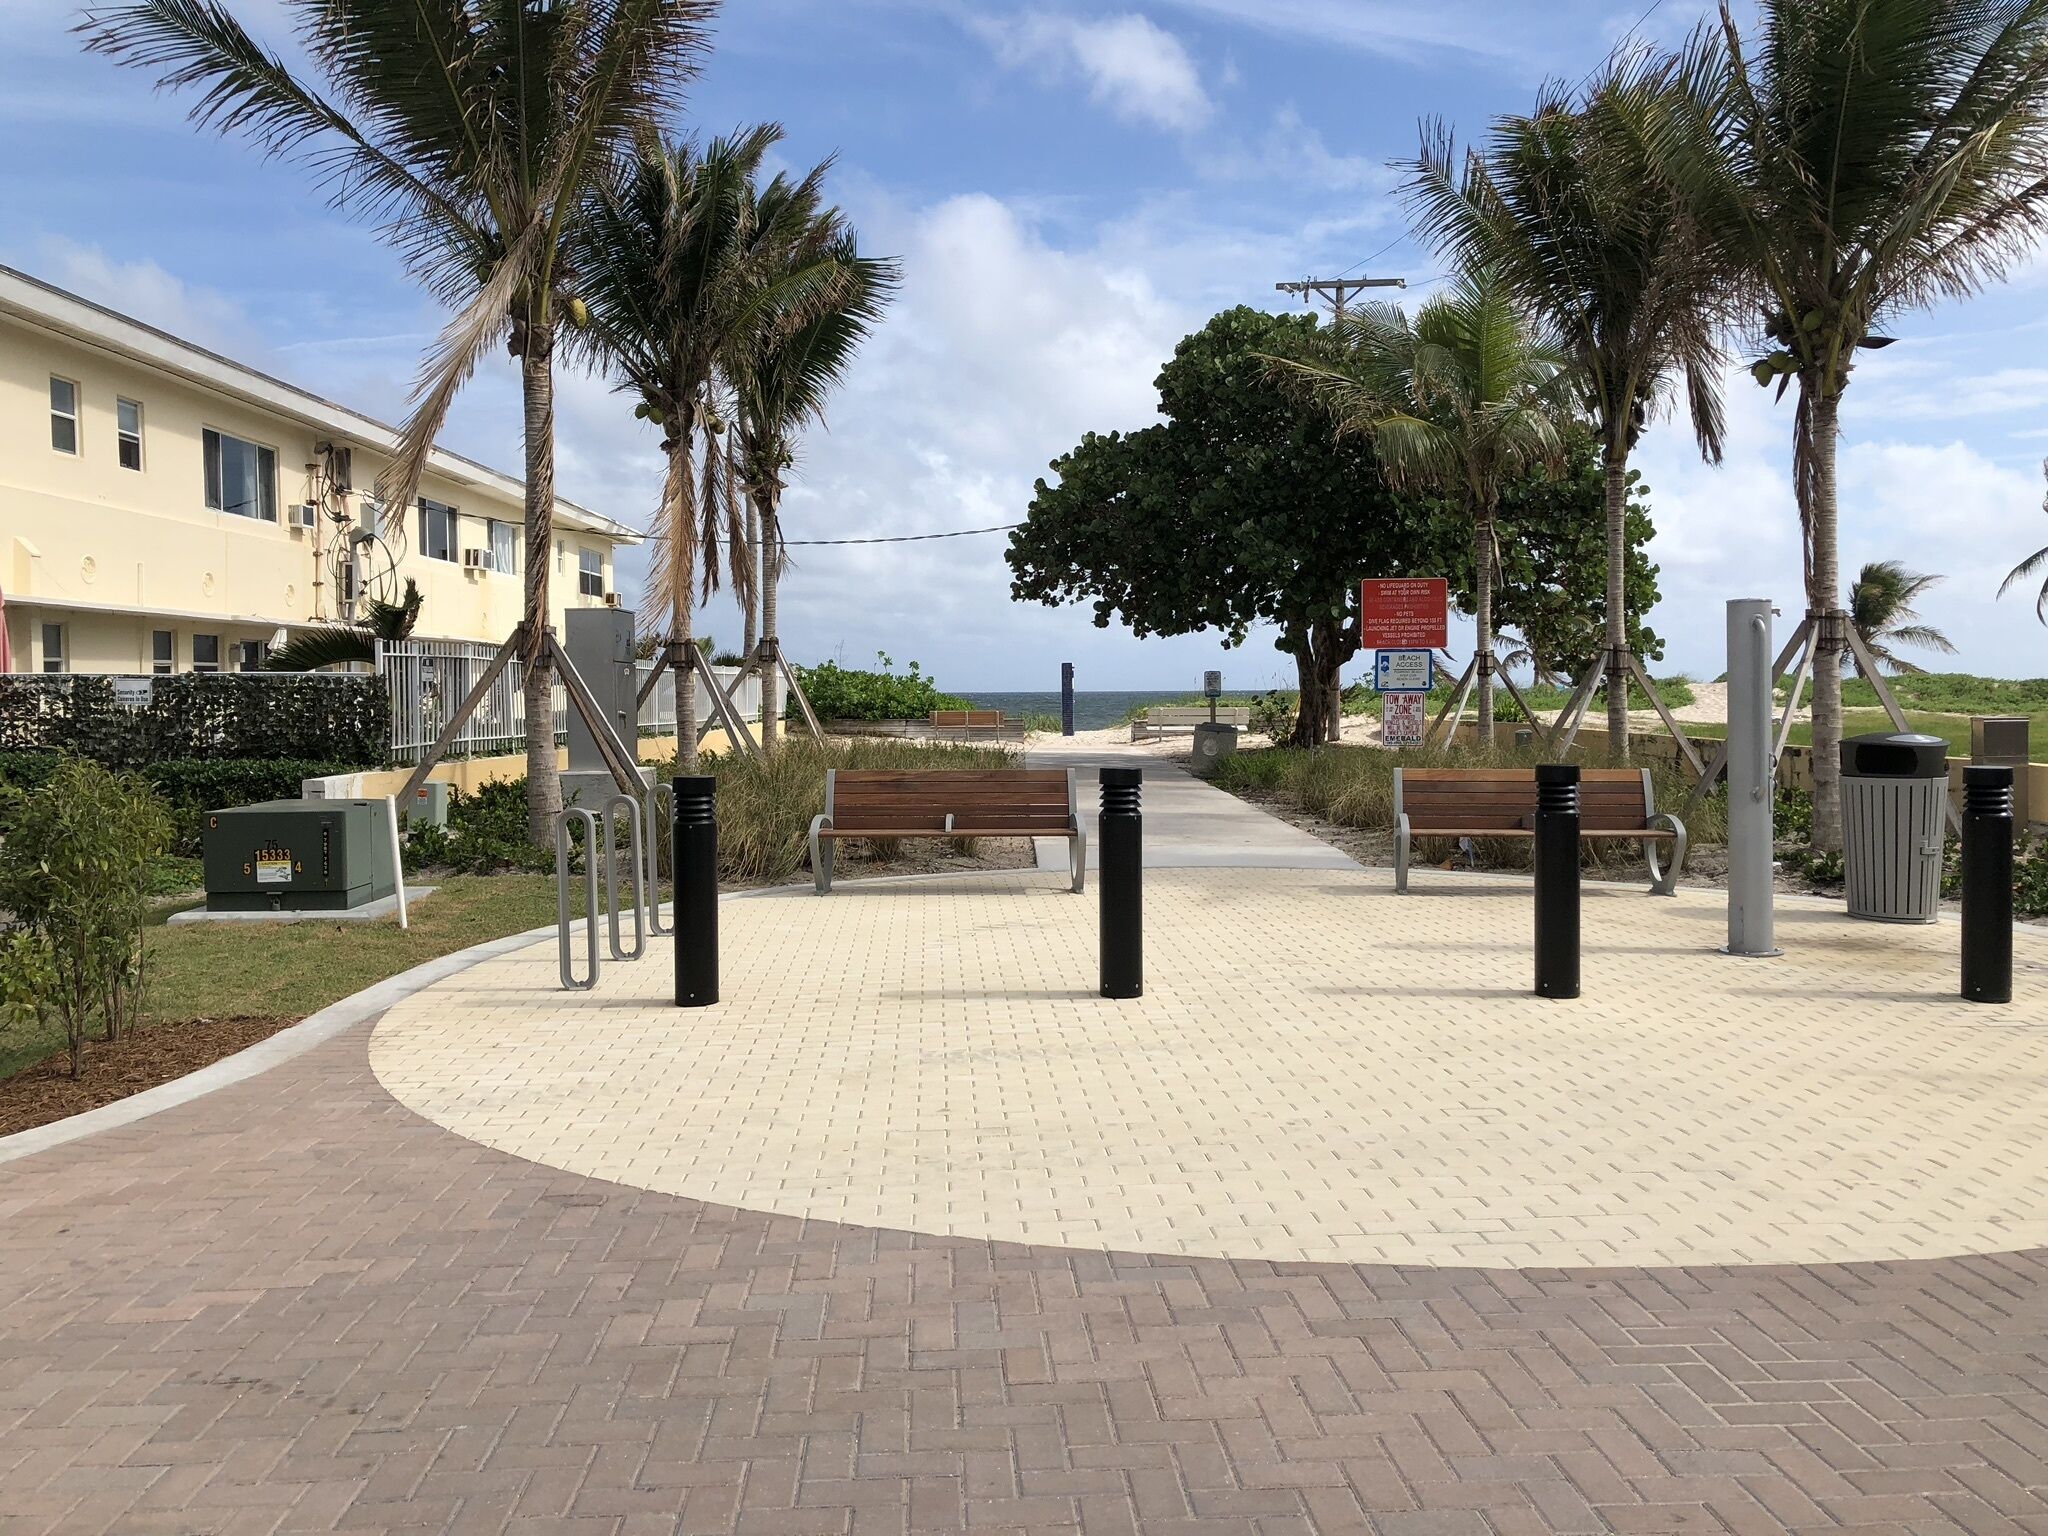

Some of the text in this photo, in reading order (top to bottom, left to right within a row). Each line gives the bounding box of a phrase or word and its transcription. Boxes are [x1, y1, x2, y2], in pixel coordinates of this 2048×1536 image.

[1386, 695, 1422, 704] TOW AWAY
[1395, 705, 1412, 714] ZONE
[210, 817, 217, 828] C
[264, 840, 278, 850] 75
[255, 849, 290, 861] 15333
[244, 863, 251, 874] 5
[295, 862, 302, 872] 4
